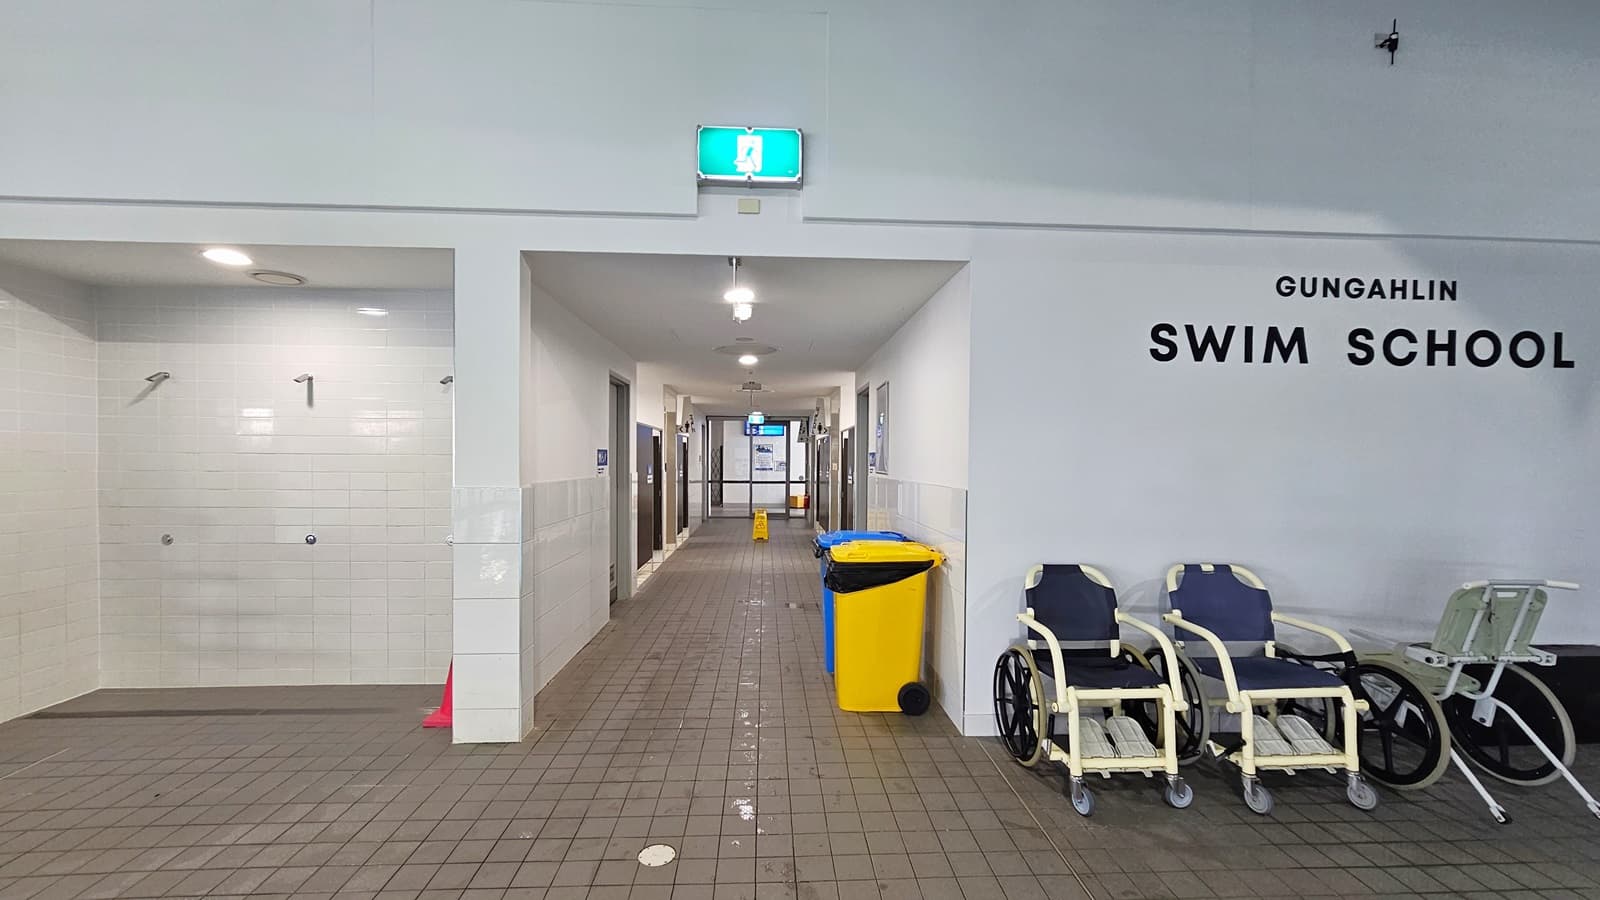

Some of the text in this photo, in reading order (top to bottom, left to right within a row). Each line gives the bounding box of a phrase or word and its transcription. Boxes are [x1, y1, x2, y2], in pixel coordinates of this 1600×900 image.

[1275, 275, 1458, 302] GUNGAHLIN
[1149, 322, 1576, 369] SWIM SCHOOL
